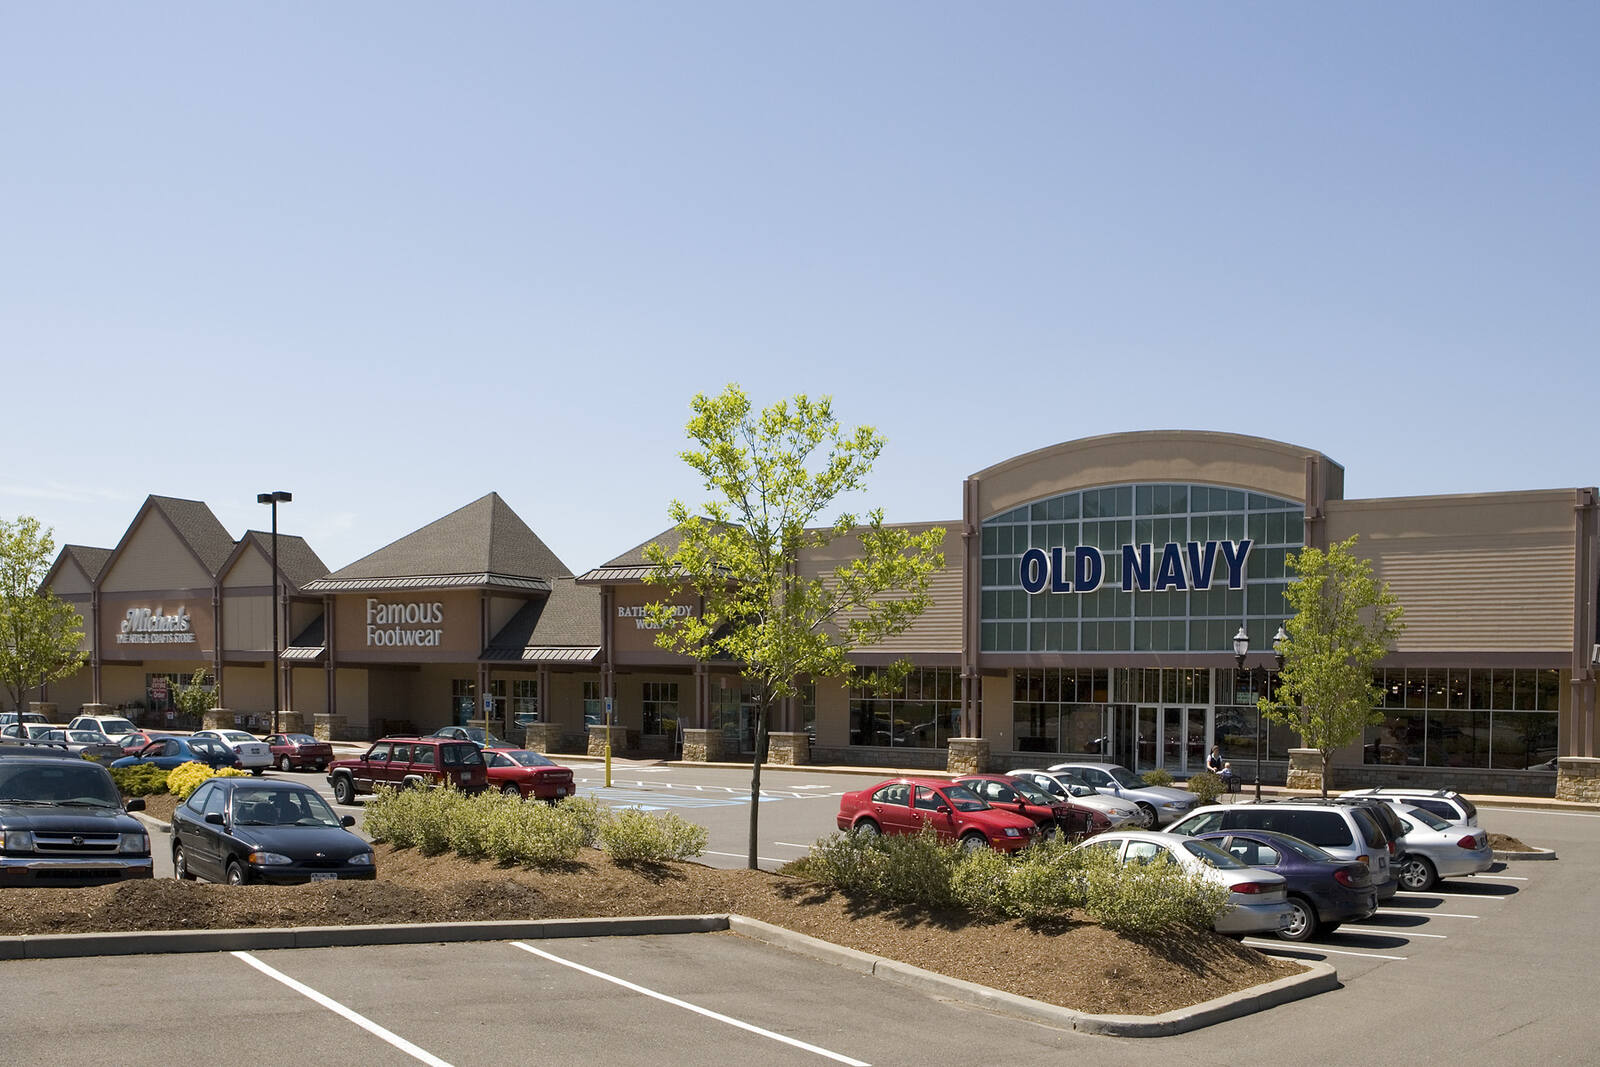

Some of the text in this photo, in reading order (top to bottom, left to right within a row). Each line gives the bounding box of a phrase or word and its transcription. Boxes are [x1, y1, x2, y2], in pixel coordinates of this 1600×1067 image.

[1019, 539, 1254, 595] OLD NAVY
[120, 606, 190, 632] Michaels
[366, 598, 443, 624] Famous
[617, 606, 647, 617] BATH
[366, 625, 443, 646] Footwear
